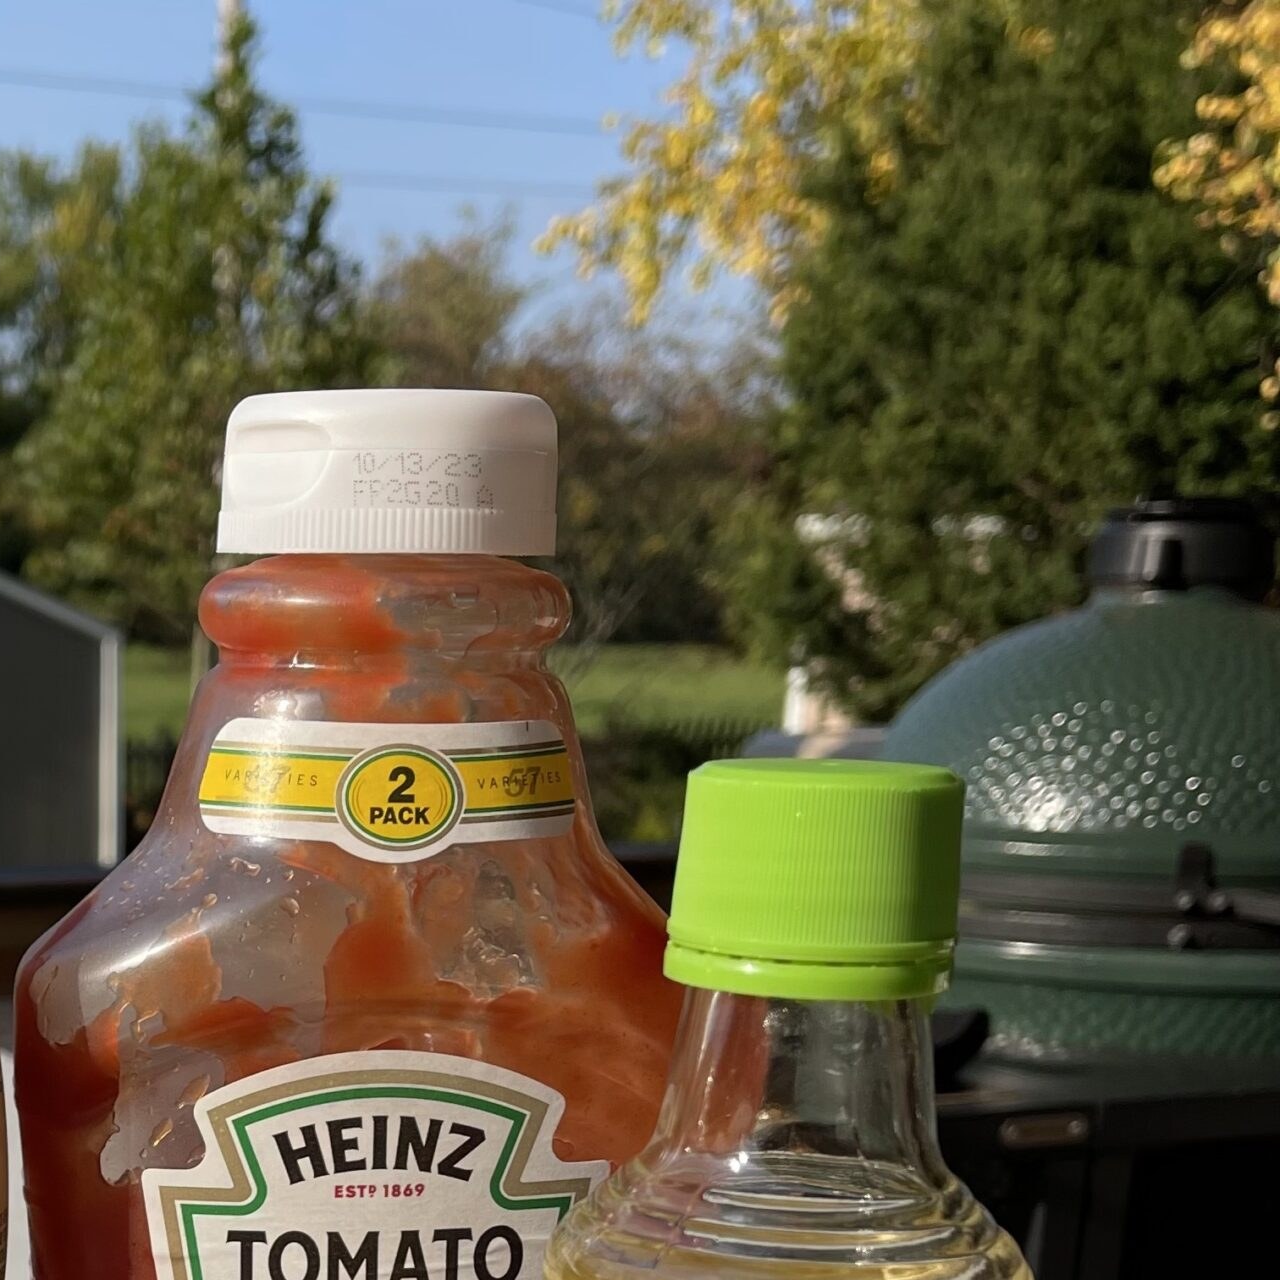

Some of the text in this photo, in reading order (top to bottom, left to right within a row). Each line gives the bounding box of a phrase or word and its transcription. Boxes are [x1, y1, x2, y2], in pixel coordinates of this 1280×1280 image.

[352, 452, 482, 478] 10/13/23
[387, 766, 416, 804] 2
[369, 806, 431, 825] PACK
[272, 1115, 487, 1185] HEINZ
[382, 1183, 425, 1198] 1869
